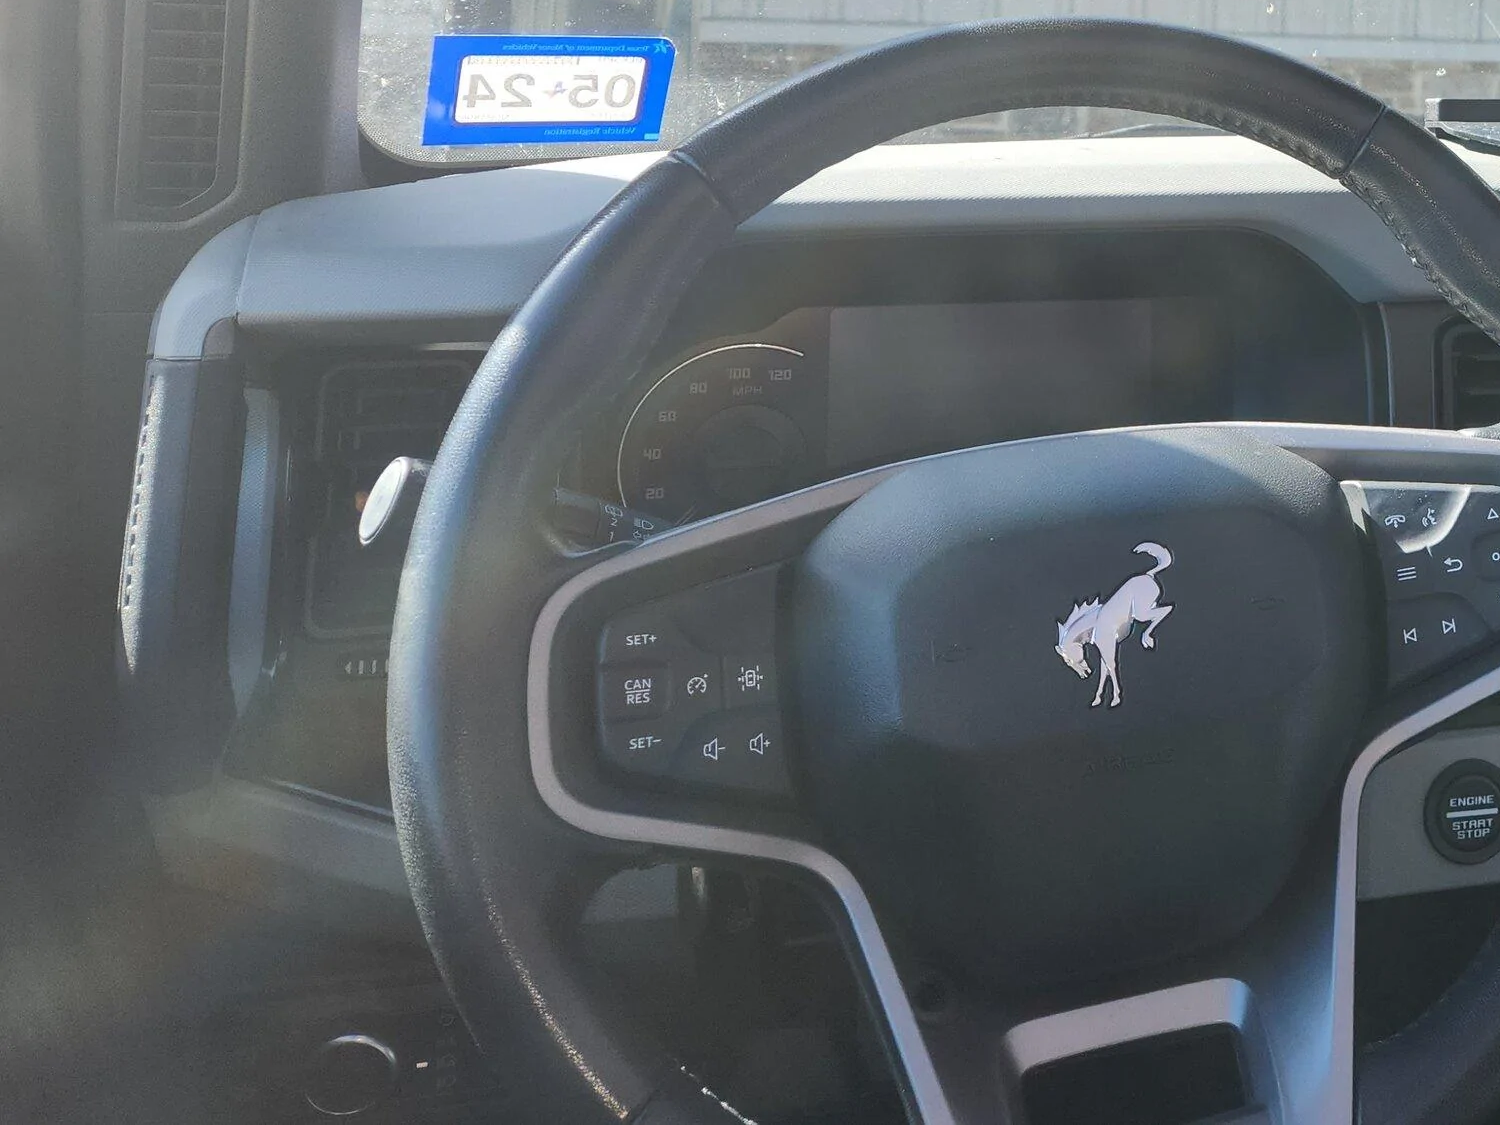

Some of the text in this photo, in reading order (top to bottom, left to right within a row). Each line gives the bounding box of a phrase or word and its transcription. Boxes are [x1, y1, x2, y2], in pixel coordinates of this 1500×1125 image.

[728, 367, 751, 380] 100
[768, 369, 792, 381] 120
[689, 382, 708, 394] 80
[732, 385, 763, 396] MPH
[643, 448, 662, 461] 40
[645, 487, 664, 500] 20
[626, 633, 658, 646] SET+
[624, 678, 652, 691] CAN
[626, 692, 651, 705] RES
[1449, 794, 1495, 807] ENGINE
[1452, 818, 1494, 831] START
[1457, 827, 1491, 840] STOP
